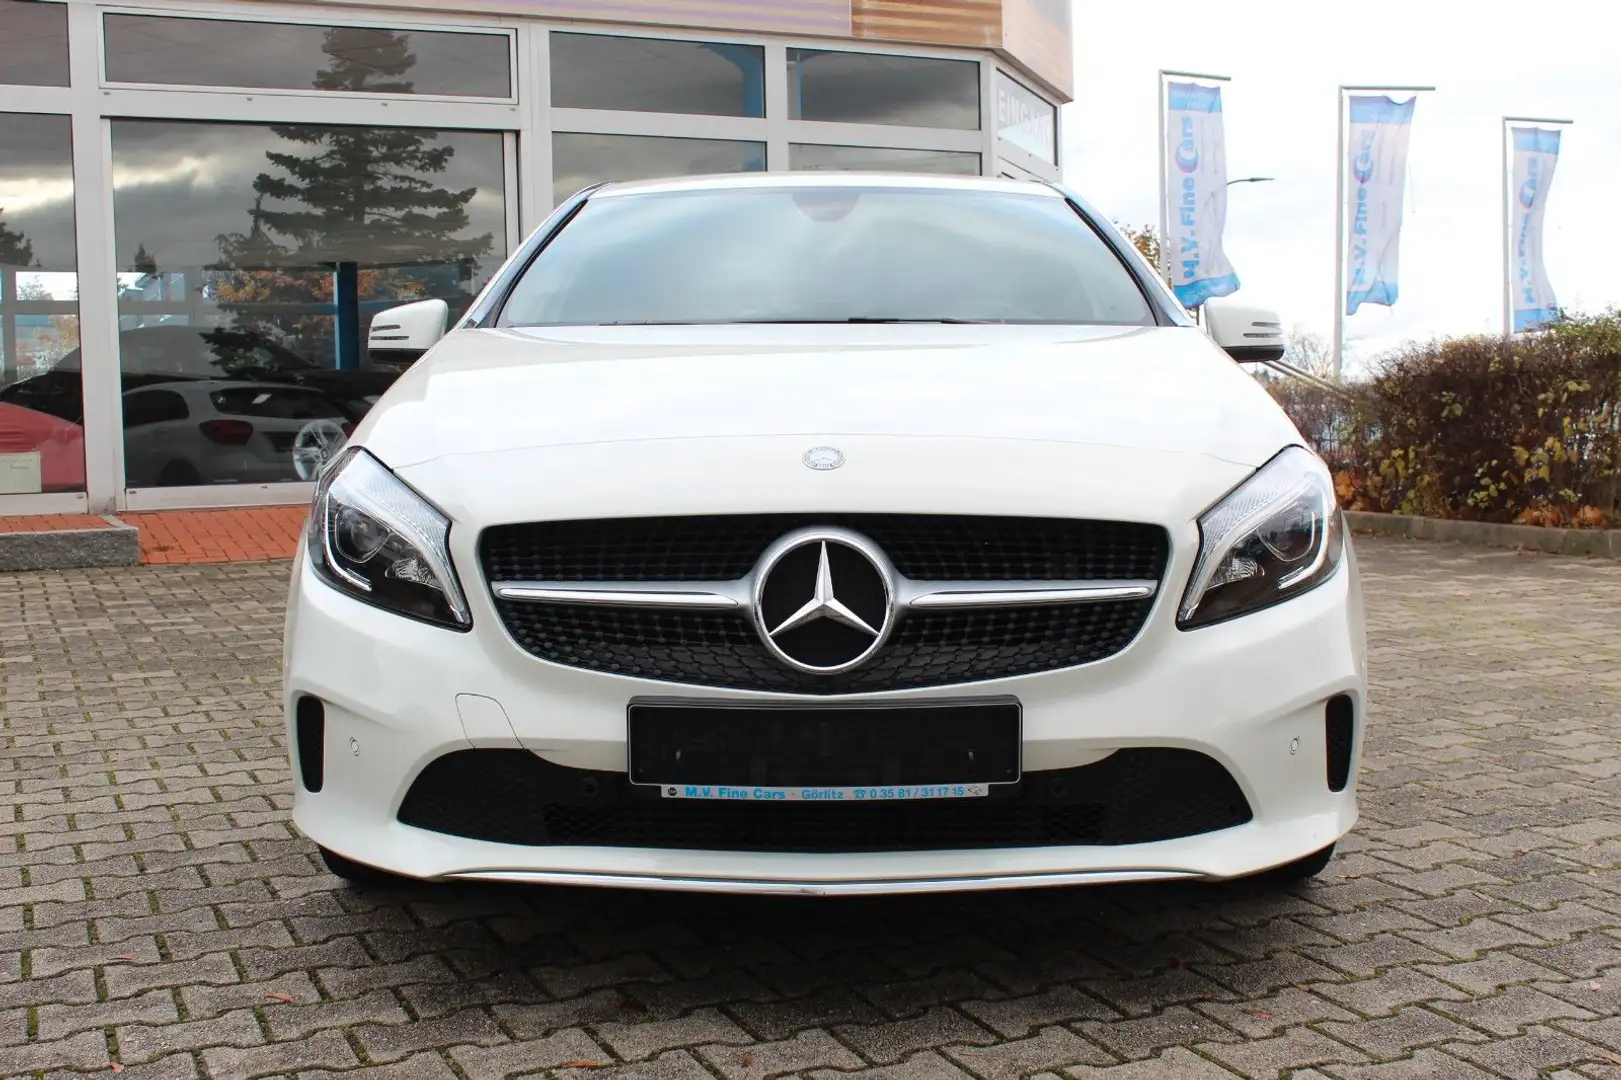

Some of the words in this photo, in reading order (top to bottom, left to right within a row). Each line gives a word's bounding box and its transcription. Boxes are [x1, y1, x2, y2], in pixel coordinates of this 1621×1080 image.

[1178, 176, 1196, 226] Fine
[685, 786, 712, 797] M.V.
[718, 787, 749, 798] Fine
[752, 788, 785, 799] Cars
[801, 788, 844, 799] Görlitz
[879, 789, 894, 799] 35
[897, 788, 910, 798] 81
[952, 786, 964, 796] 15
